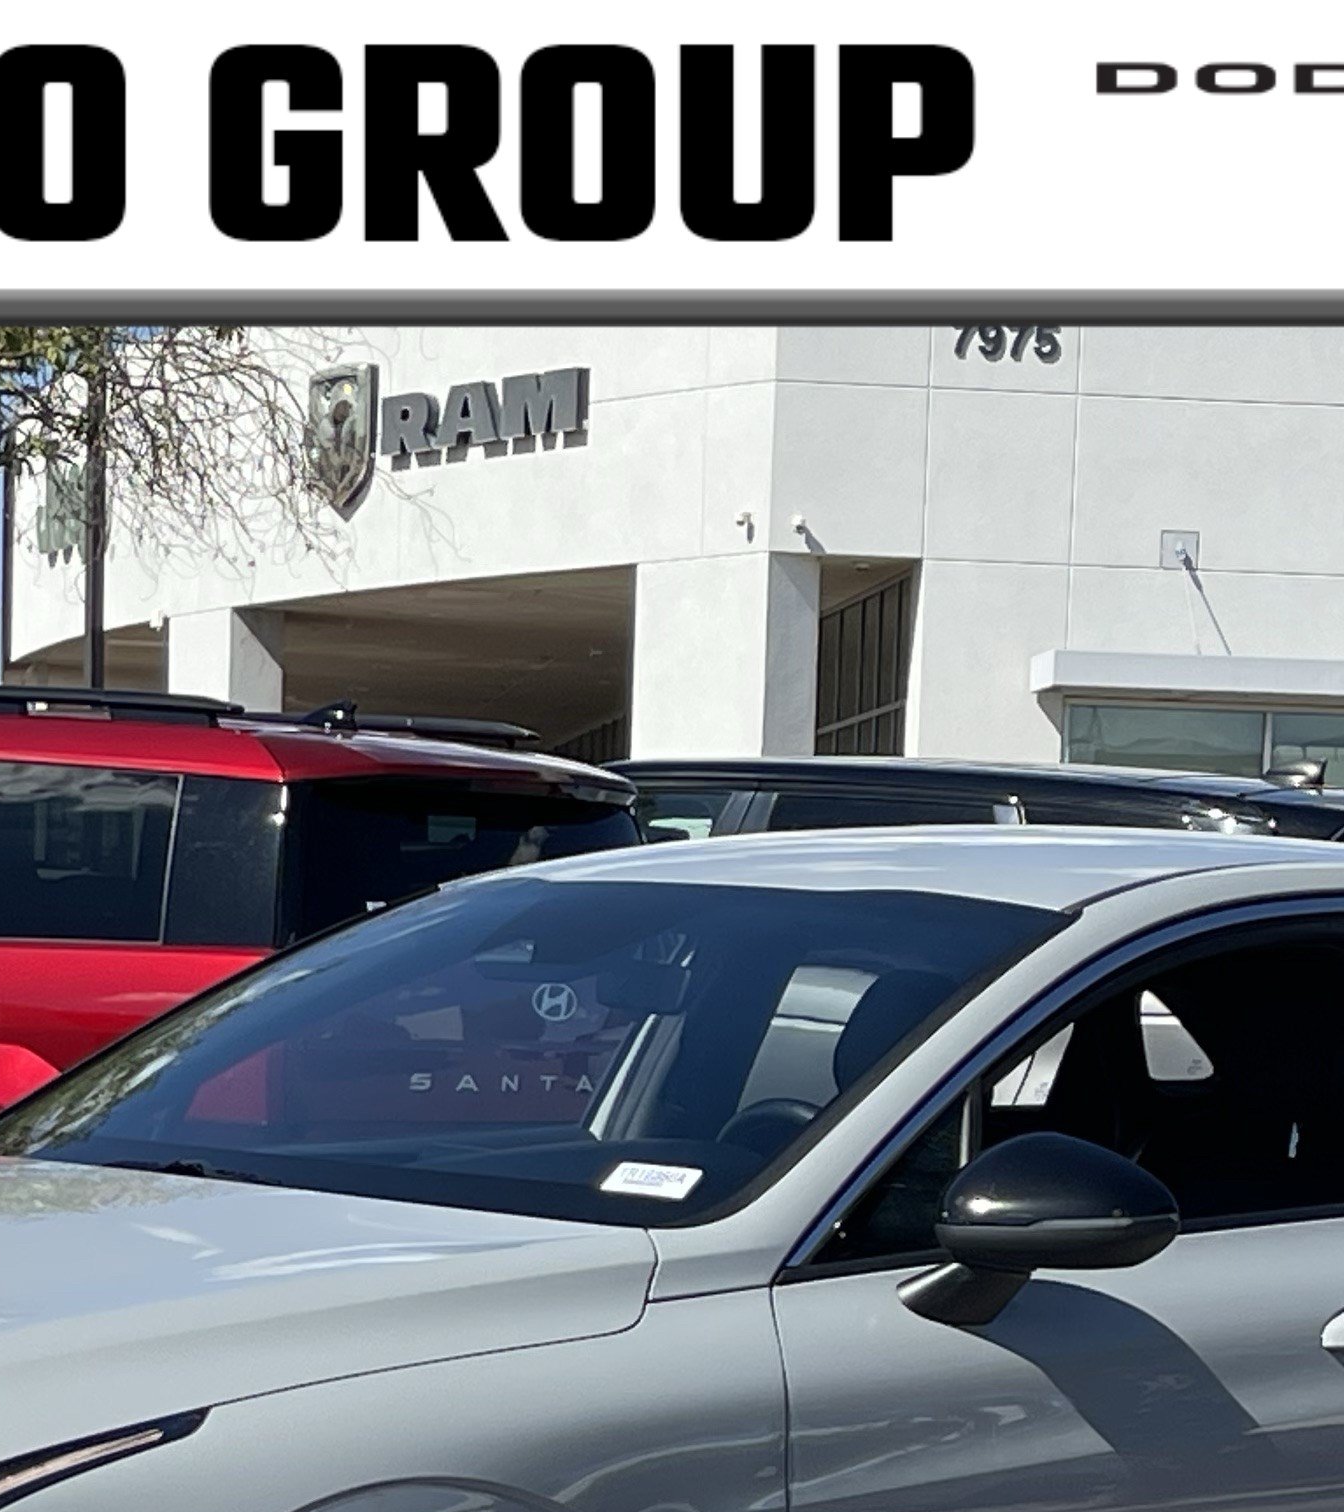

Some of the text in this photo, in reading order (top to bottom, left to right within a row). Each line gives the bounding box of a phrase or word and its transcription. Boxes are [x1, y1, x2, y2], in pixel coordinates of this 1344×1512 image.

[952, 326, 1062, 363] 7975
[381, 367, 591, 456] RAM
[409, 1072, 594, 1093] SANTA
